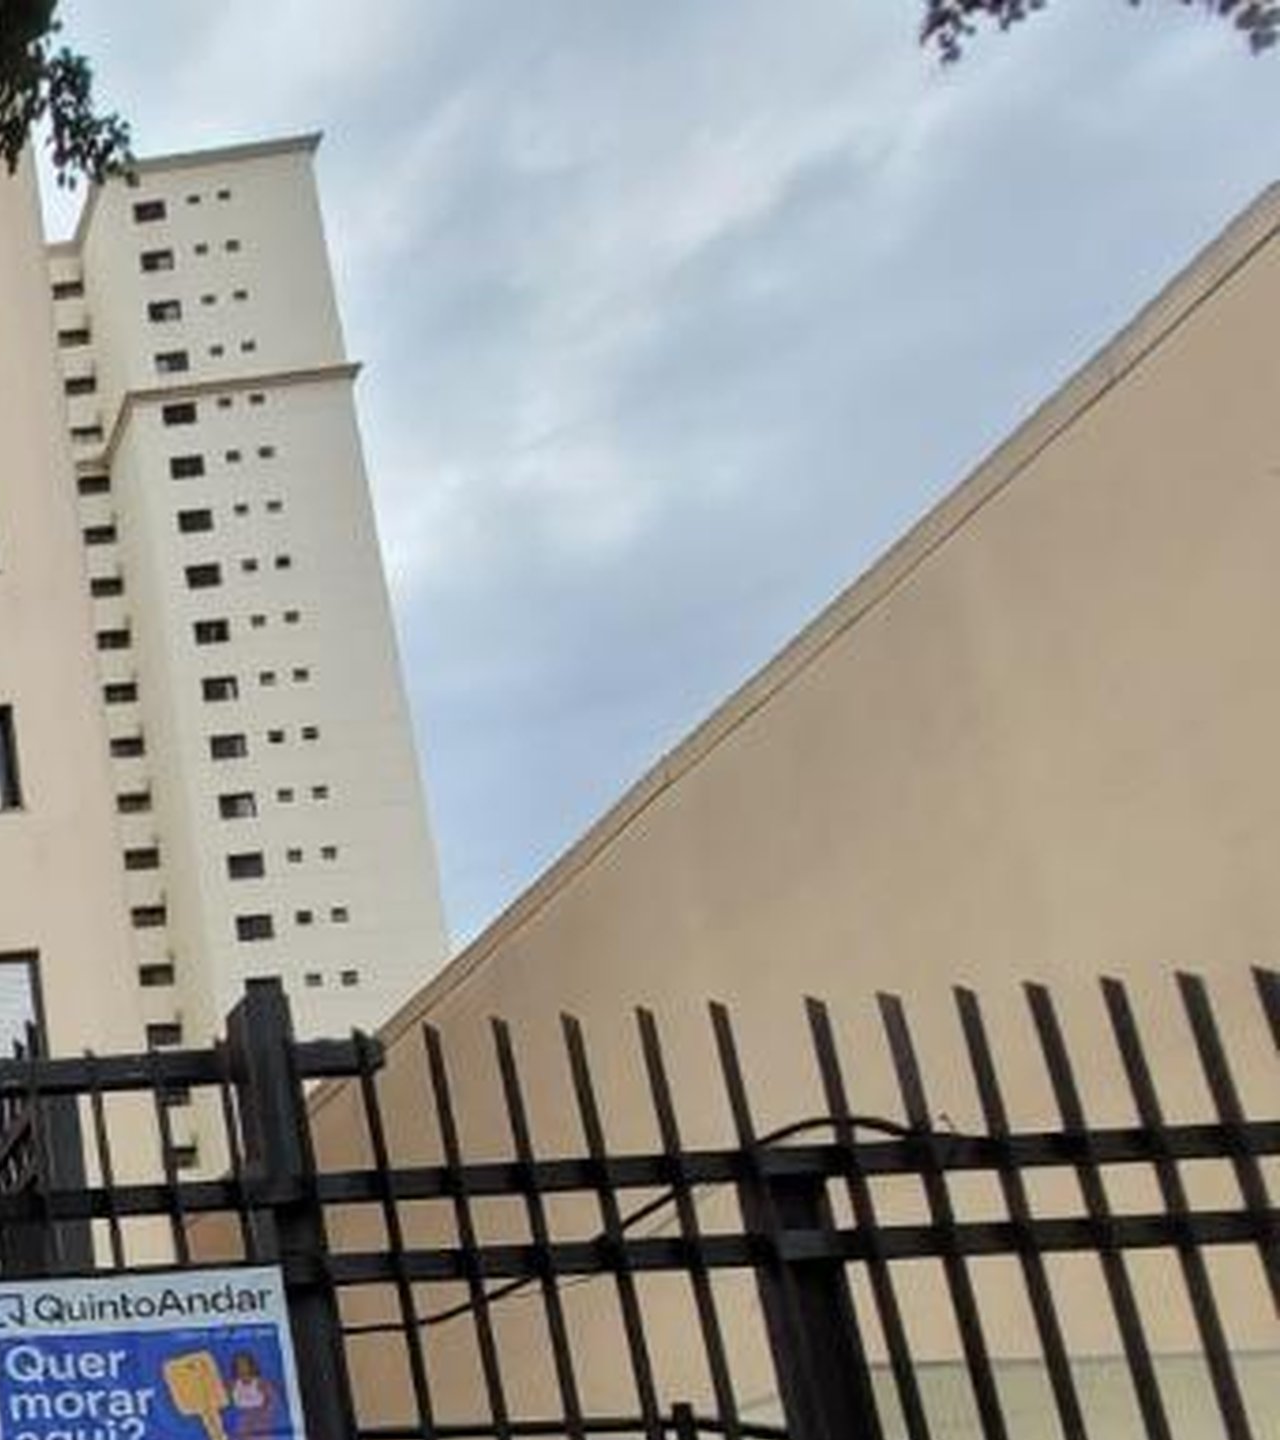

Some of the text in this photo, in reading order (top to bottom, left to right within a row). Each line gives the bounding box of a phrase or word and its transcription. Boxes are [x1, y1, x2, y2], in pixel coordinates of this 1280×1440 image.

[32, 1285, 274, 1324] QuintoAndar
[5, 1345, 127, 1383] Quer
[10, 1388, 156, 1422] morar
